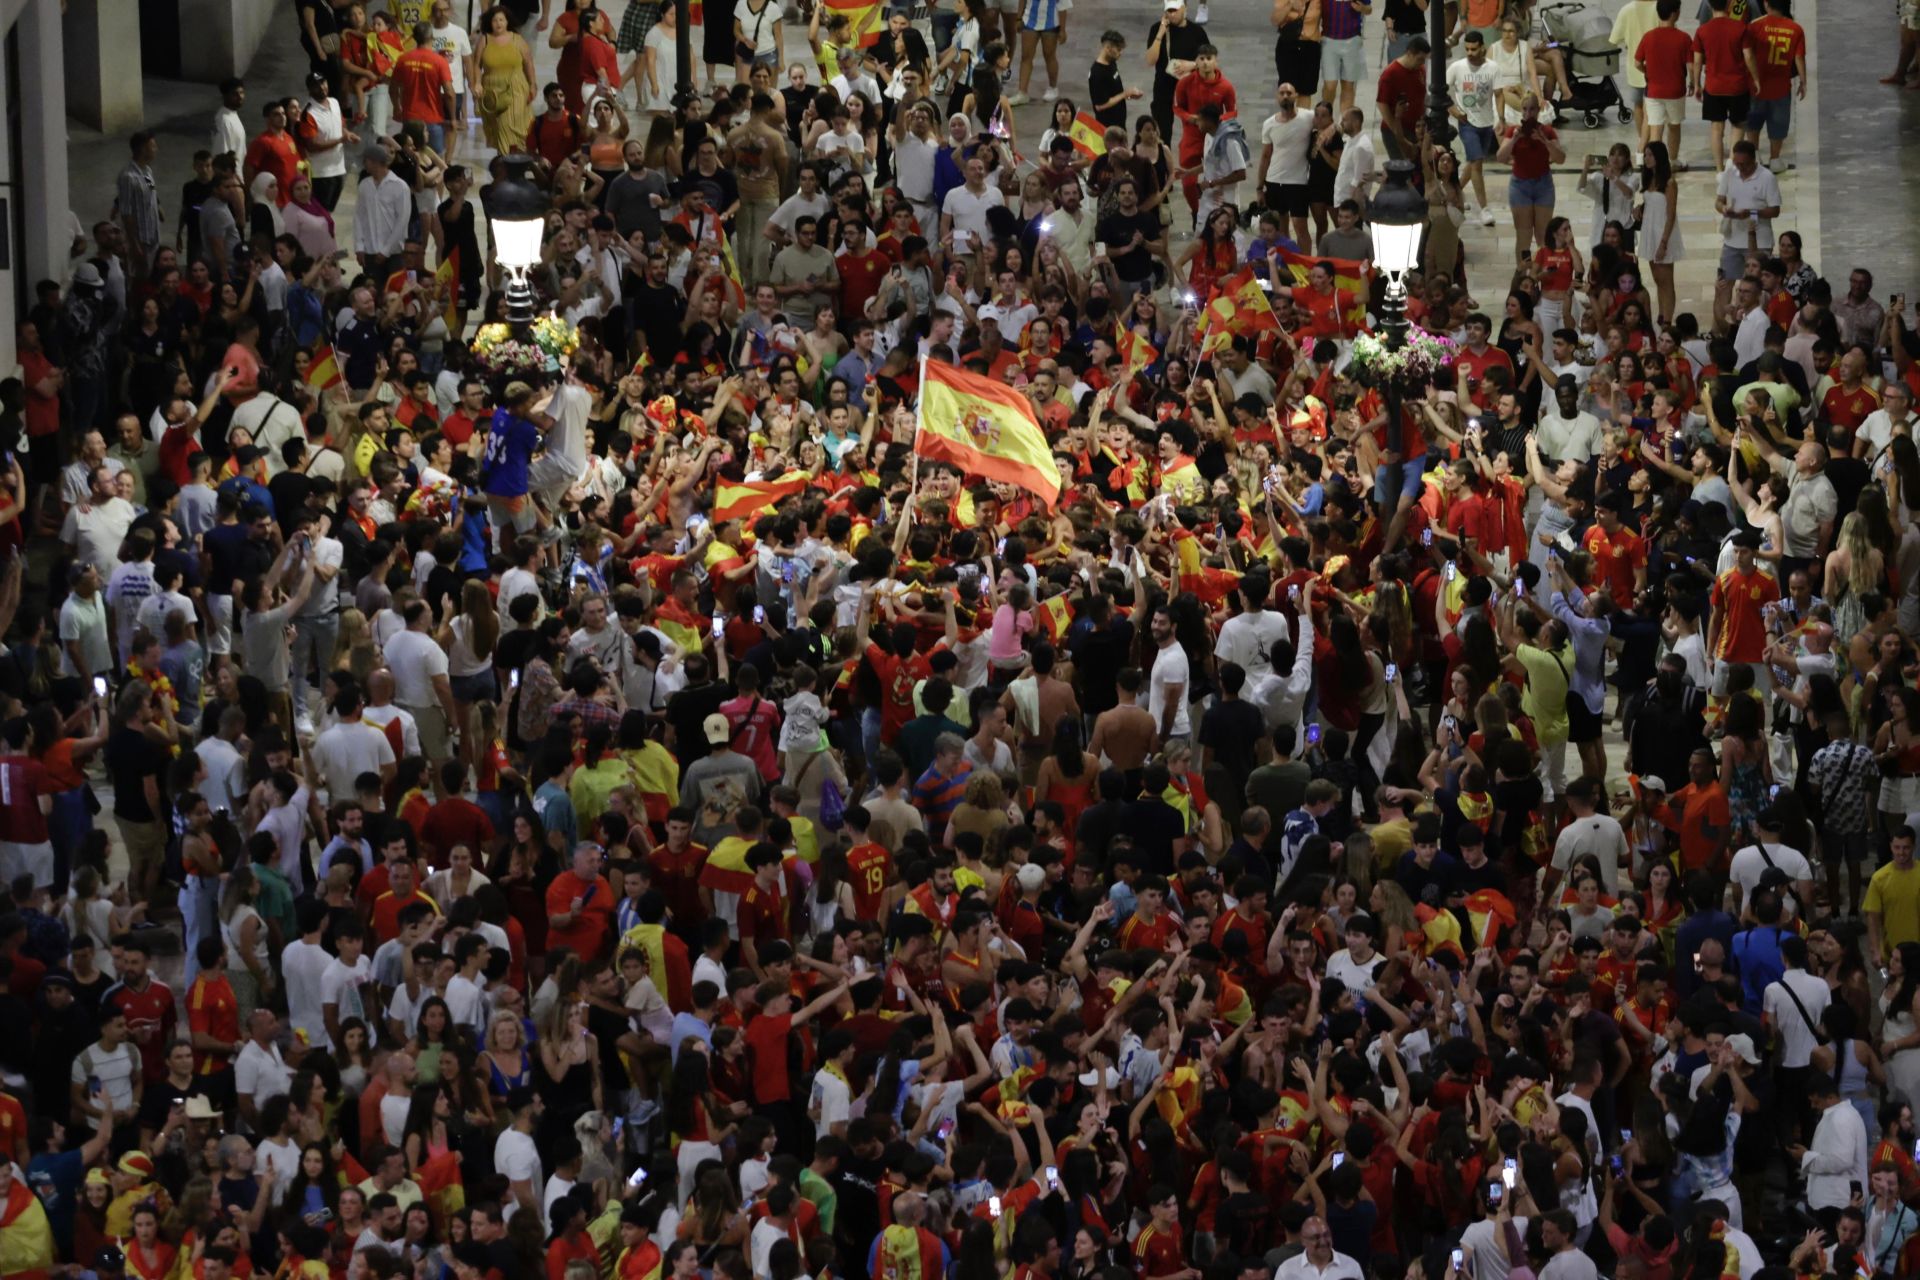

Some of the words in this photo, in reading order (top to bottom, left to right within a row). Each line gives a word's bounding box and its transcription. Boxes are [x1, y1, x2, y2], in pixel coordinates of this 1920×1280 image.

[403, 8, 419, 23] 23
[1767, 34, 1790, 65] 12
[745, 725, 757, 752] 7
[865, 866, 883, 895] 19
